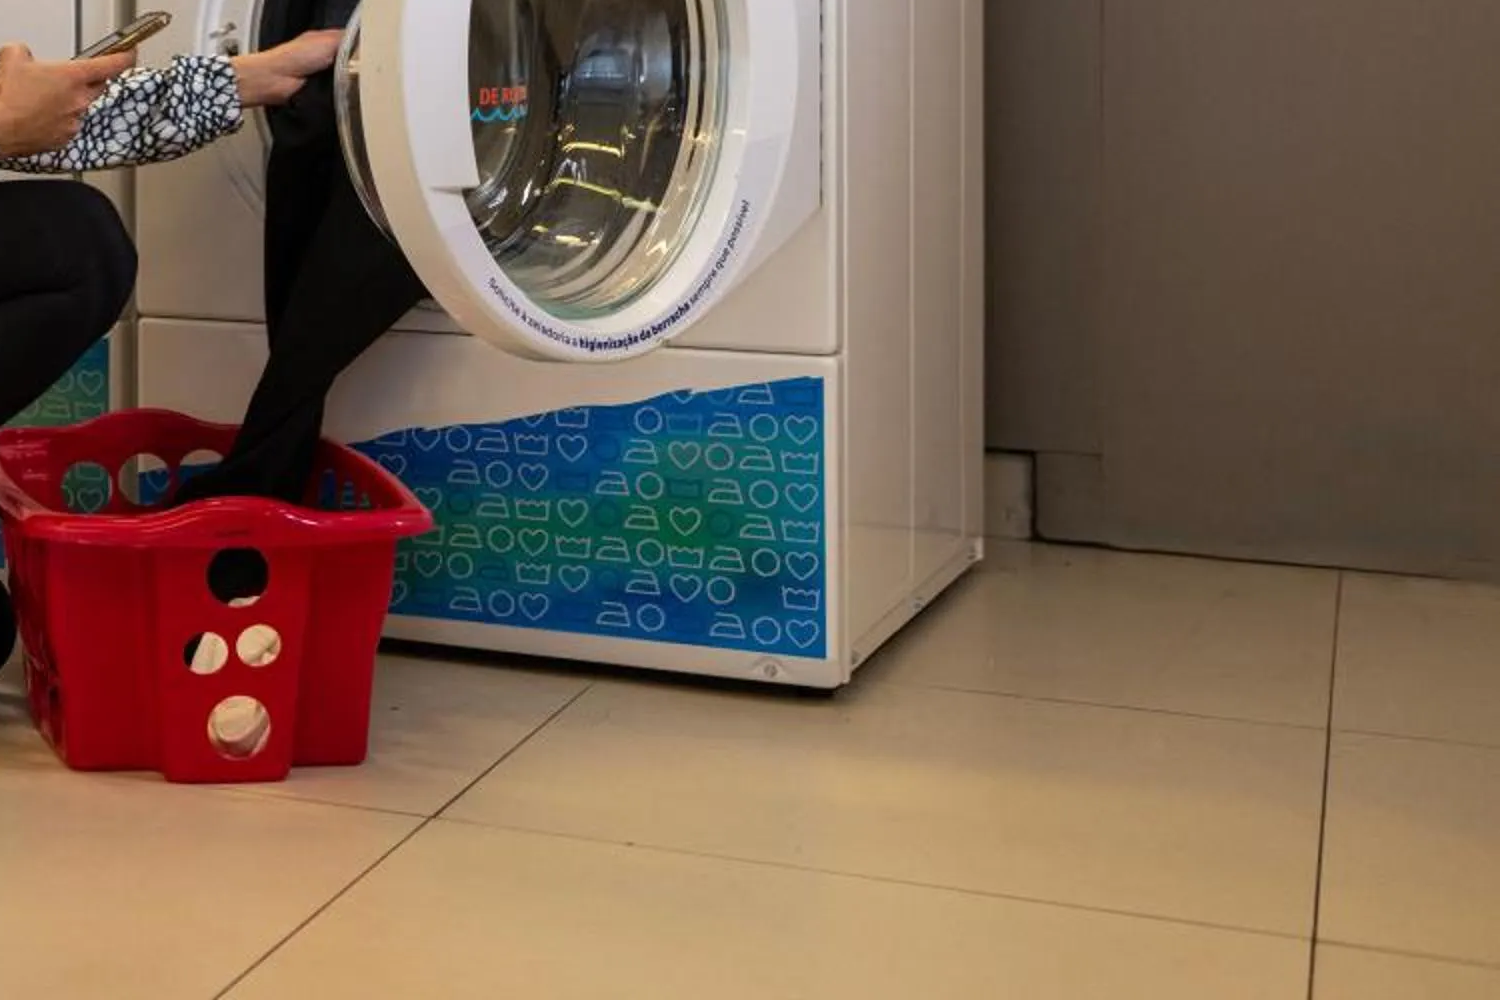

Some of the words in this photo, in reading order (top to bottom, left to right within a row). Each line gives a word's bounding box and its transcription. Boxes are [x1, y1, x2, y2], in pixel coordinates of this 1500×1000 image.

[651, 302, 690, 335] borracha
[689, 269, 717, 305] sempre
[716, 247, 731, 271] que
